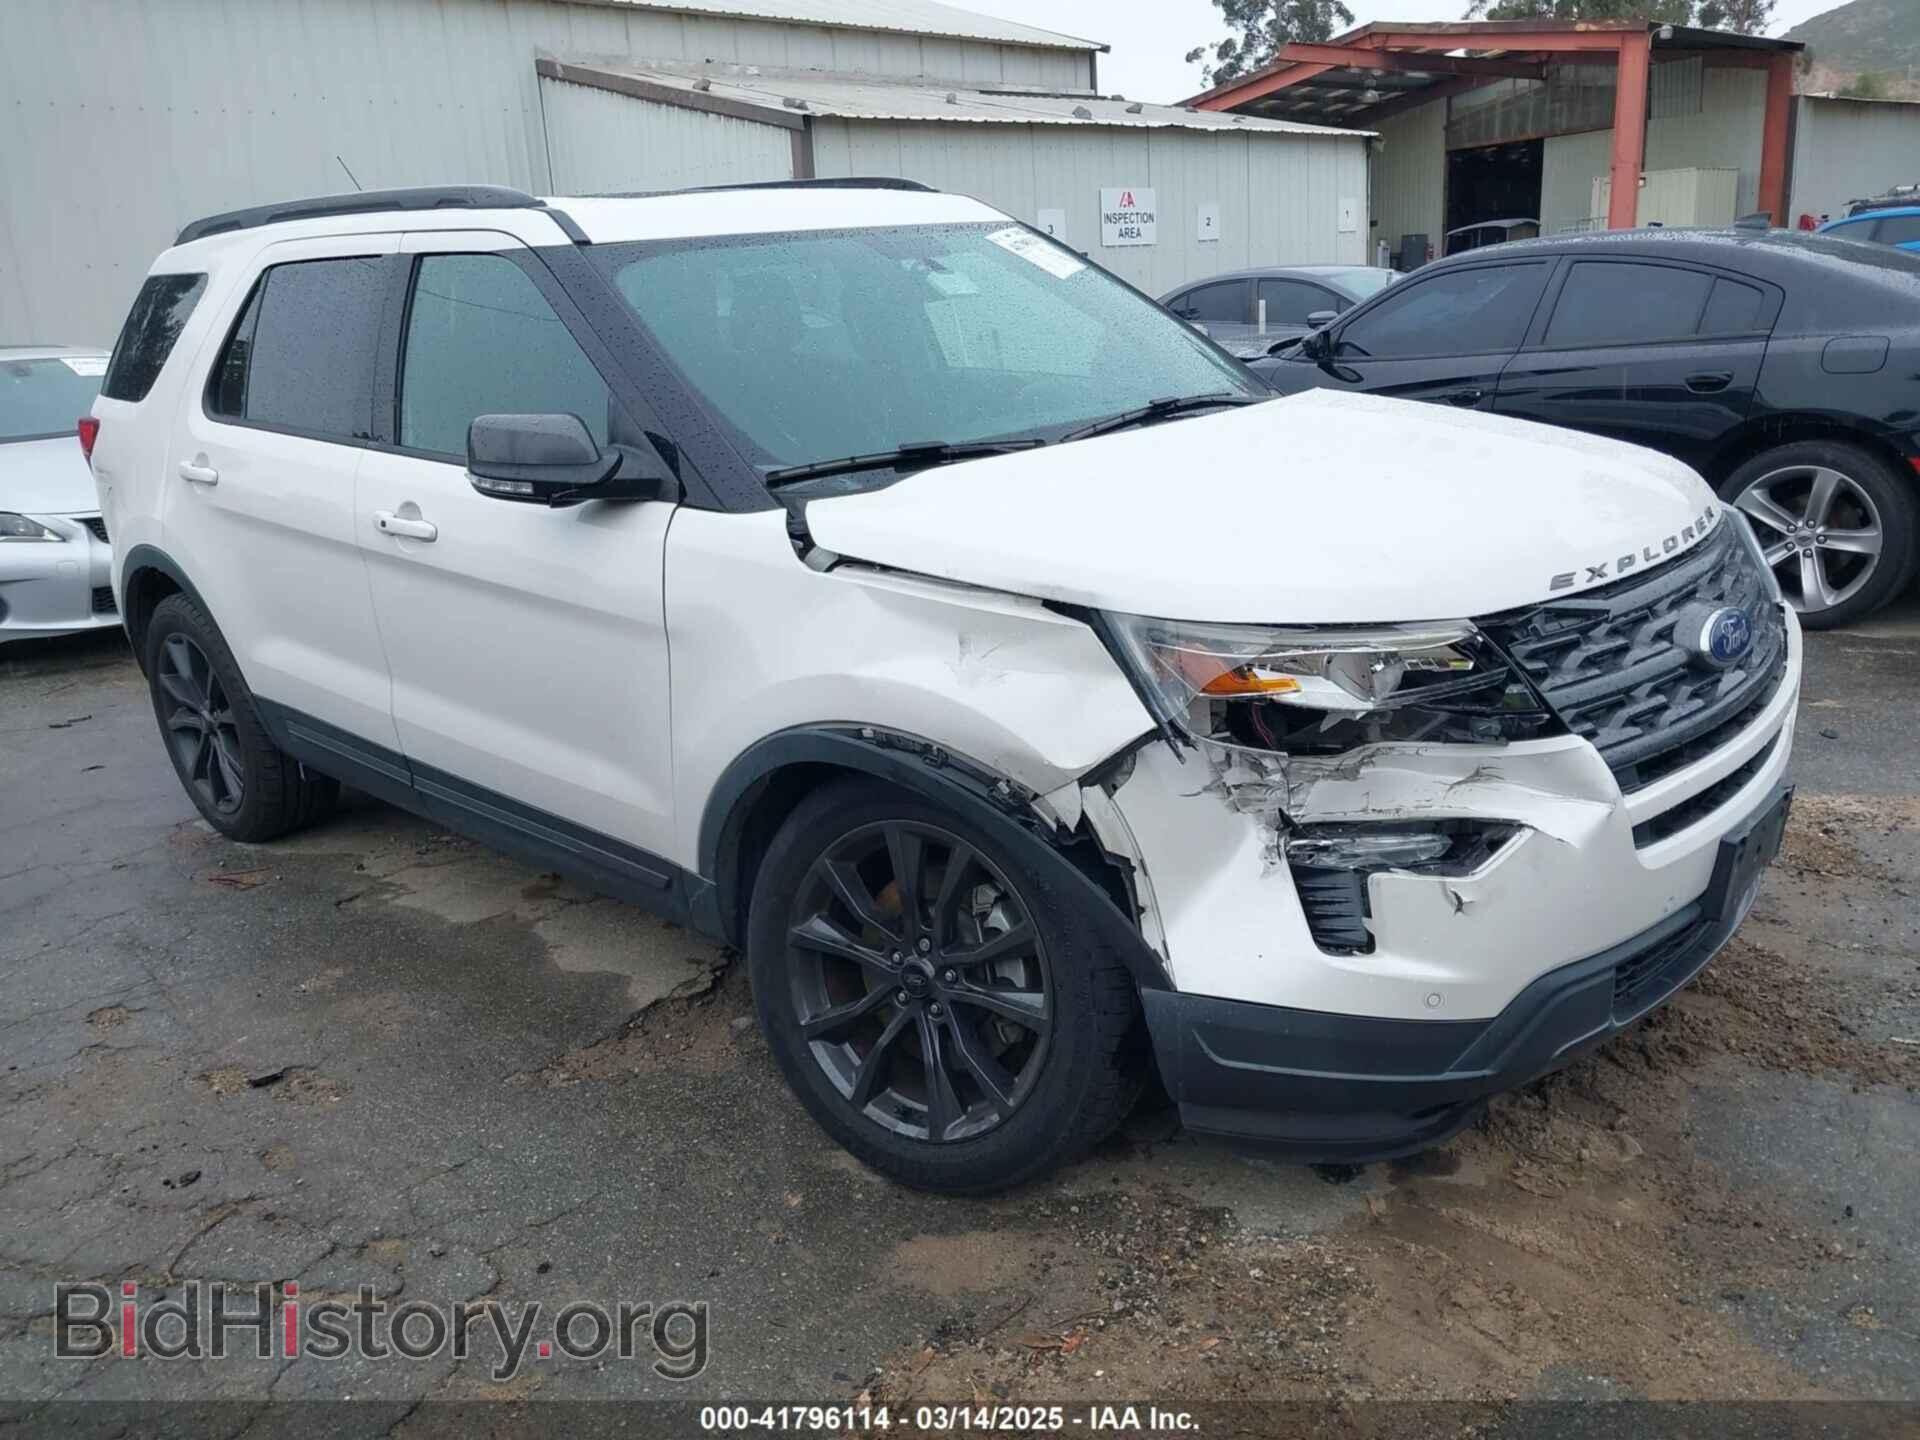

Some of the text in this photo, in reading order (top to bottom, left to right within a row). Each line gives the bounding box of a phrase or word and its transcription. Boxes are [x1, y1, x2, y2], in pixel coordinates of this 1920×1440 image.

[1103, 211, 1155, 224] INSPECTION
[1205, 216, 1212, 227] 2
[1047, 224, 1055, 235] 3
[1118, 226, 1142, 239] AREA
[1549, 505, 1715, 592] EXPLORER
[1720, 617, 1749, 654] Ford
